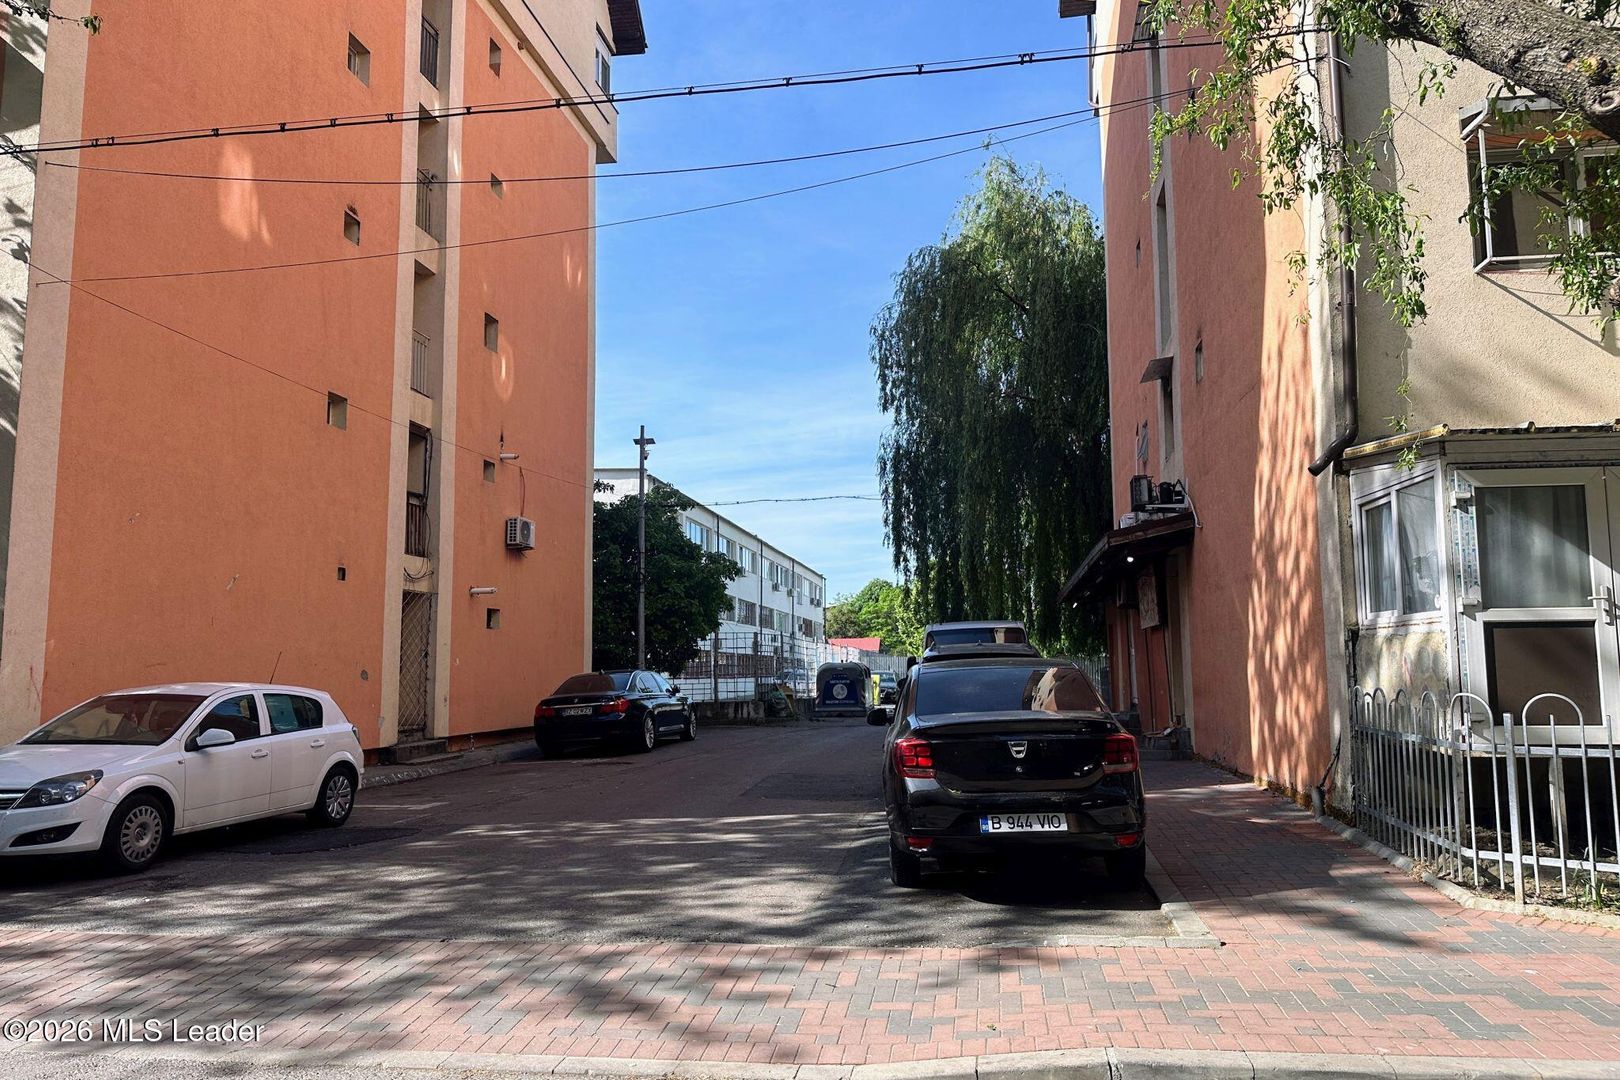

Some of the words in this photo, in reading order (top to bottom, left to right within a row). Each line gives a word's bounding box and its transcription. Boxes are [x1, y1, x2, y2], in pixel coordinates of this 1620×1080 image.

[991, 816, 1001, 830] B
[1007, 815, 1033, 829] 944
[1037, 814, 1061, 829] VIO
